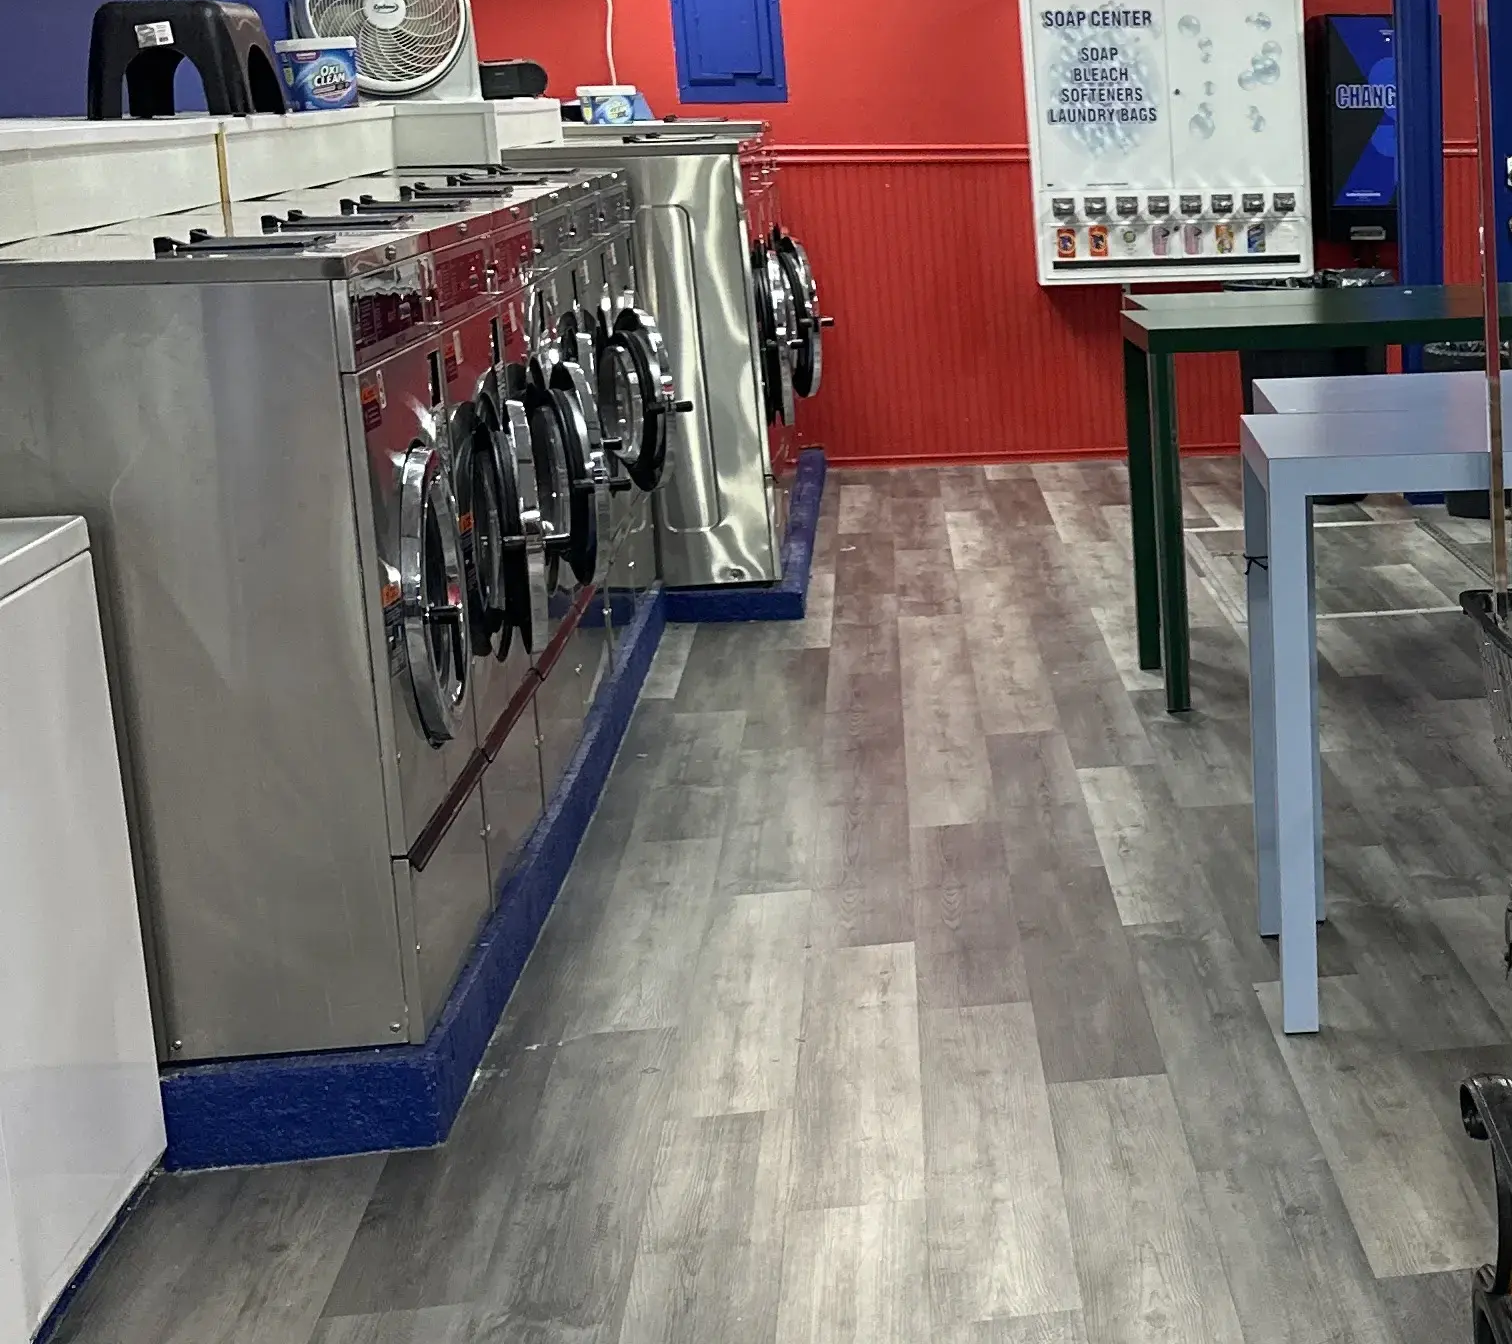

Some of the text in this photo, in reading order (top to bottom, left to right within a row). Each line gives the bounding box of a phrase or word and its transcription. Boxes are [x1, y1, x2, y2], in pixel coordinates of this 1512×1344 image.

[1043, 10, 1152, 27] SOAP CENTER
[1081, 47, 1118, 61] SOAP
[320, 65, 339, 76] OXI
[1073, 67, 1129, 82] BLEACH
[313, 72, 346, 87] CLEAN
[1061, 87, 1143, 102] SOFTENERS
[1335, 83, 1397, 109] CHANG
[1049, 107, 1158, 123] LAUNDRY BAGS
